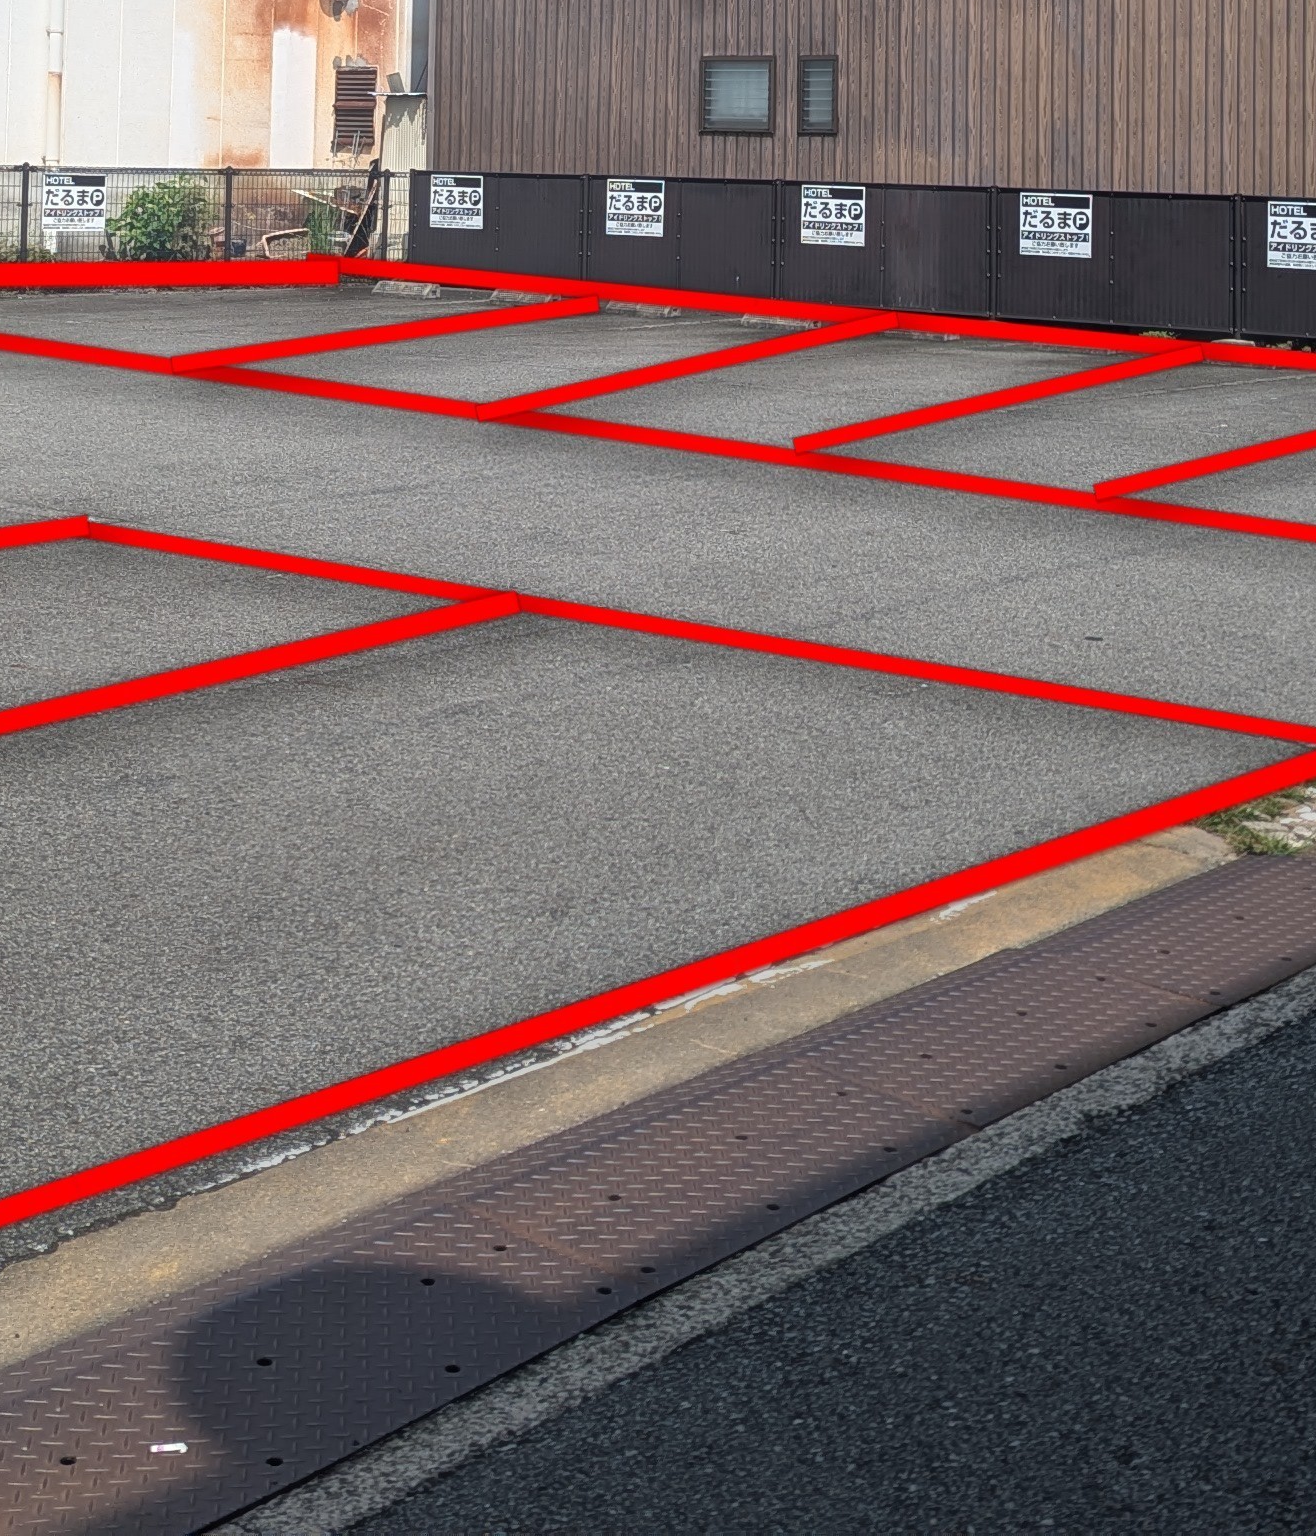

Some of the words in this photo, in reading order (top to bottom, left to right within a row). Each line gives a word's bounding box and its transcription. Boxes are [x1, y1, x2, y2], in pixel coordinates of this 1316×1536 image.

[46, 176, 75, 184] HOTEL
[610, 183, 635, 191] HOTEL
[804, 189, 832, 197] HOTEL
[1023, 197, 1055, 206] HOTEL
[1271, 205, 1307, 215] HOTEL
